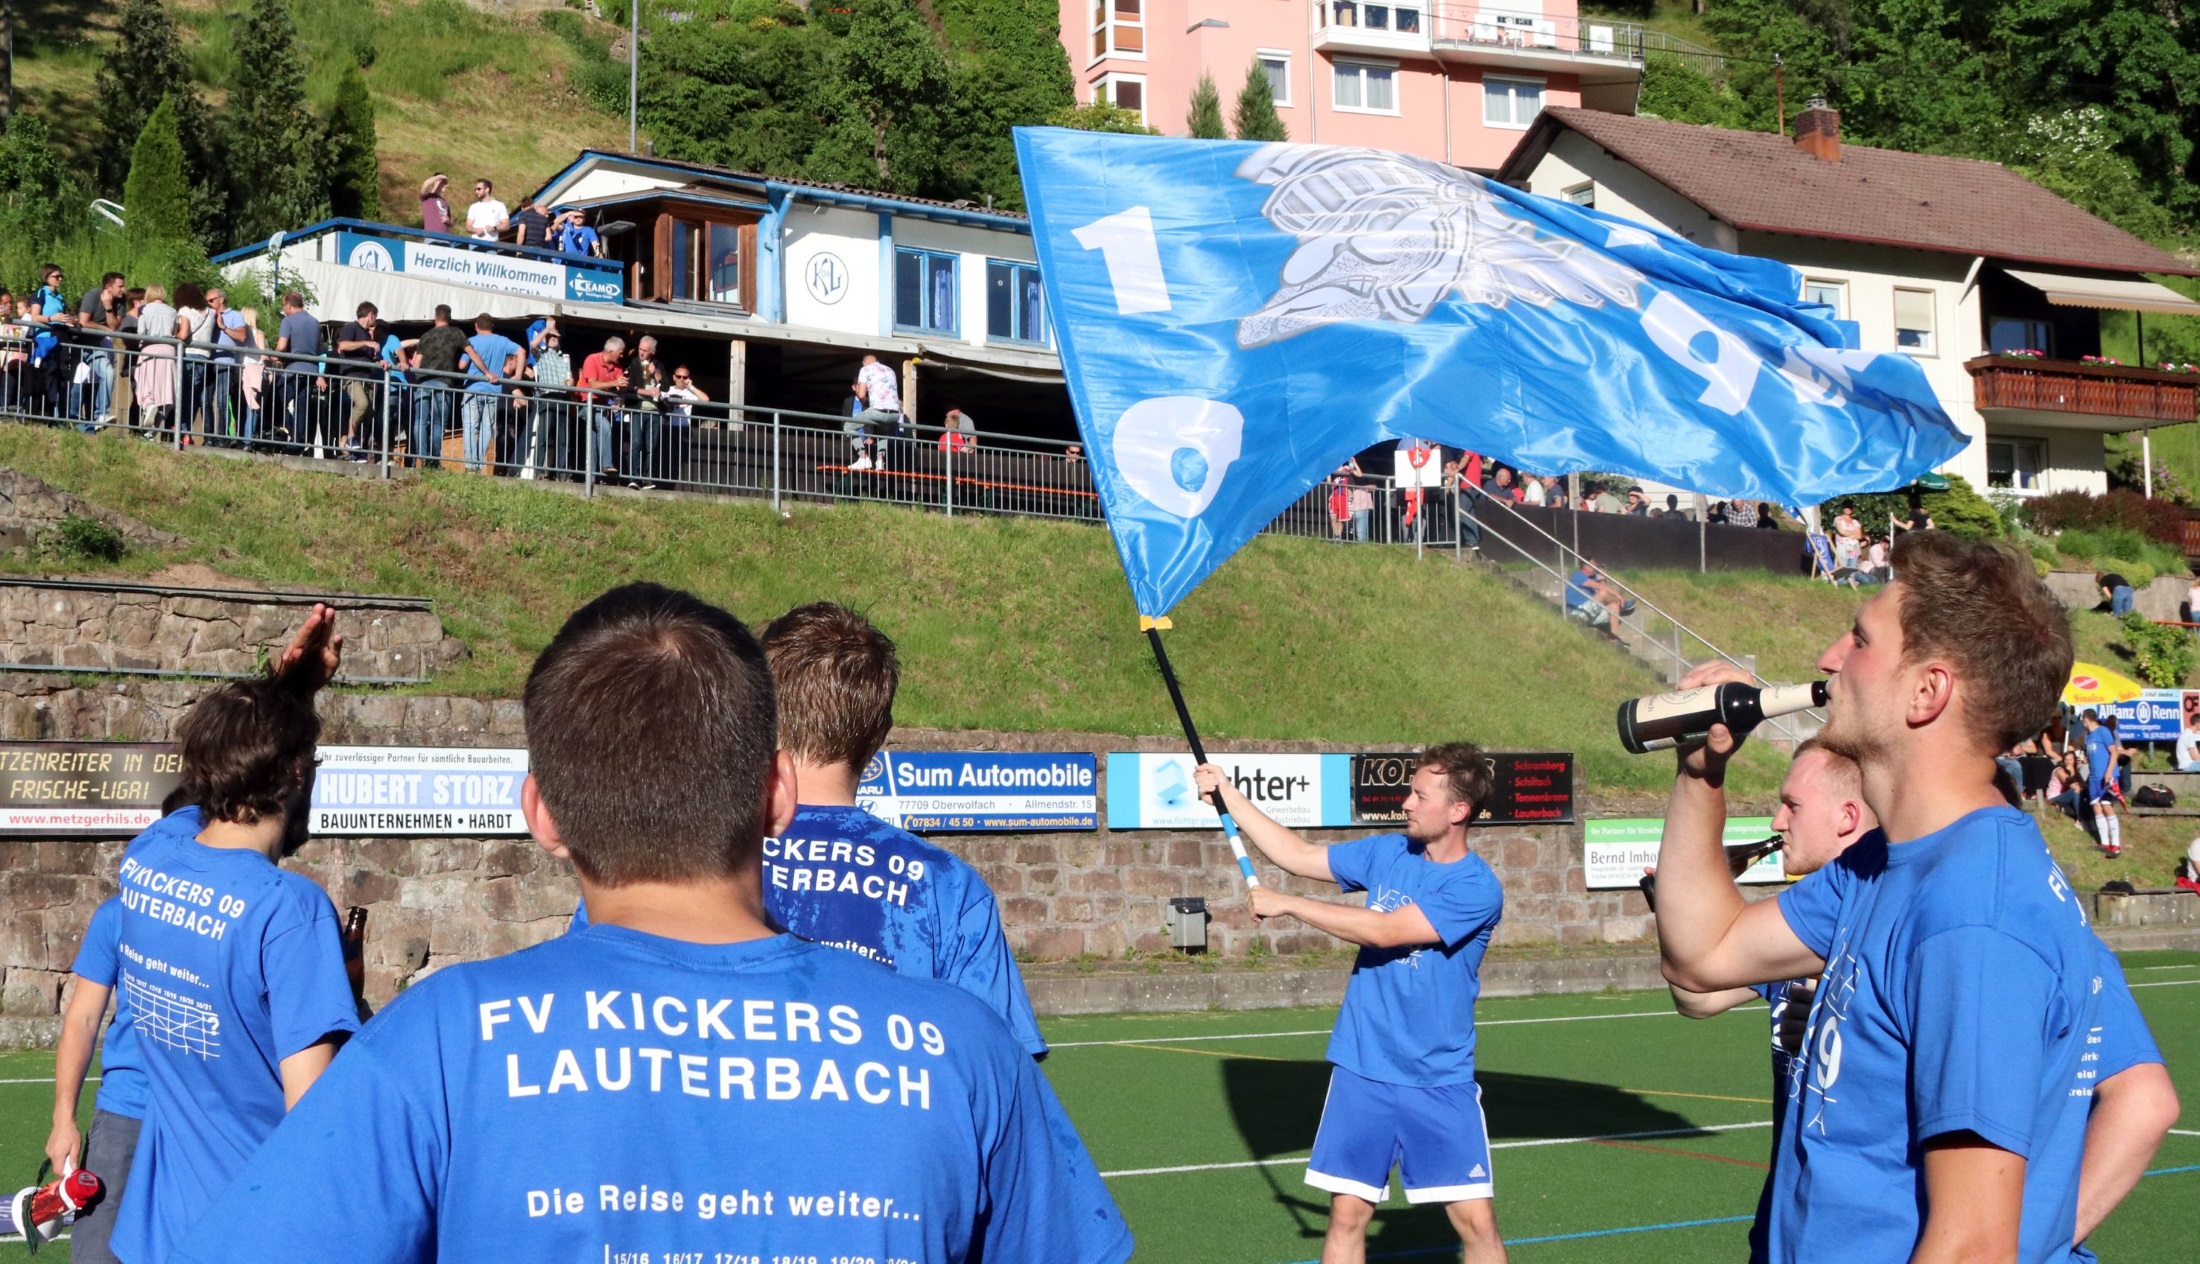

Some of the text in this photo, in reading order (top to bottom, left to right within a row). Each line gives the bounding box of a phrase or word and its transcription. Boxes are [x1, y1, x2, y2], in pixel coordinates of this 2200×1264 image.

[1070, 205, 1172, 315] 1
[414, 252, 558, 286] Herzlich Willkommen
[585, 281, 613, 294] KAMO
[2073, 694, 2105, 703] Sinalco
[2098, 705, 2180, 720] Allianz Renn
[123, 753, 143, 772] IN
[321, 752, 513, 764] Ihr zuverlässiger Partner für sämtliche Bauarbeiten.
[1514, 761, 1566, 772] Schramberg
[898, 763, 1093, 787] Sum Automobile
[1514, 776, 1552, 787] Schiltach
[320, 773, 514, 805] HUBERT STORZ
[1226, 765, 1310, 801] hter+
[898, 799, 1093, 810] 77709 Oberwolfach Allmendstr. 15
[1514, 792, 1569, 803] Tennenbronn
[1266, 806, 1311, 814] Gewerbebau
[1514, 808, 1562, 818] Lauterbach
[9, 813, 151, 827] www.metzgerhils.de
[321, 813, 513, 829] BAUUNTERNEHMEN HARDT
[912, 817, 941, 827] 07834
[949, 817, 960, 827] 45
[962, 817, 974, 827] 50
[984, 817, 1093, 827] www.sum-automobile.de
[1153, 815, 1221, 827] www.fichter-gewe
[1272, 815, 1311, 824] dustriebau
[763, 836, 925, 881] CKERS 09
[1591, 851, 1625, 864] Bernd
[771, 863, 908, 907] ERBACH
[132, 868, 215, 907] KICKERS
[218, 894, 246, 918] 09
[120, 886, 227, 941] AUTERBACH
[145, 957, 168, 974] geht
[170, 965, 210, 989] weiter...
[478, 990, 946, 1057] FV KICKERS 09
[506, 1046, 931, 1110] LAUTERBACH
[526, 1184, 921, 1221] Die Reise geht weiter...
